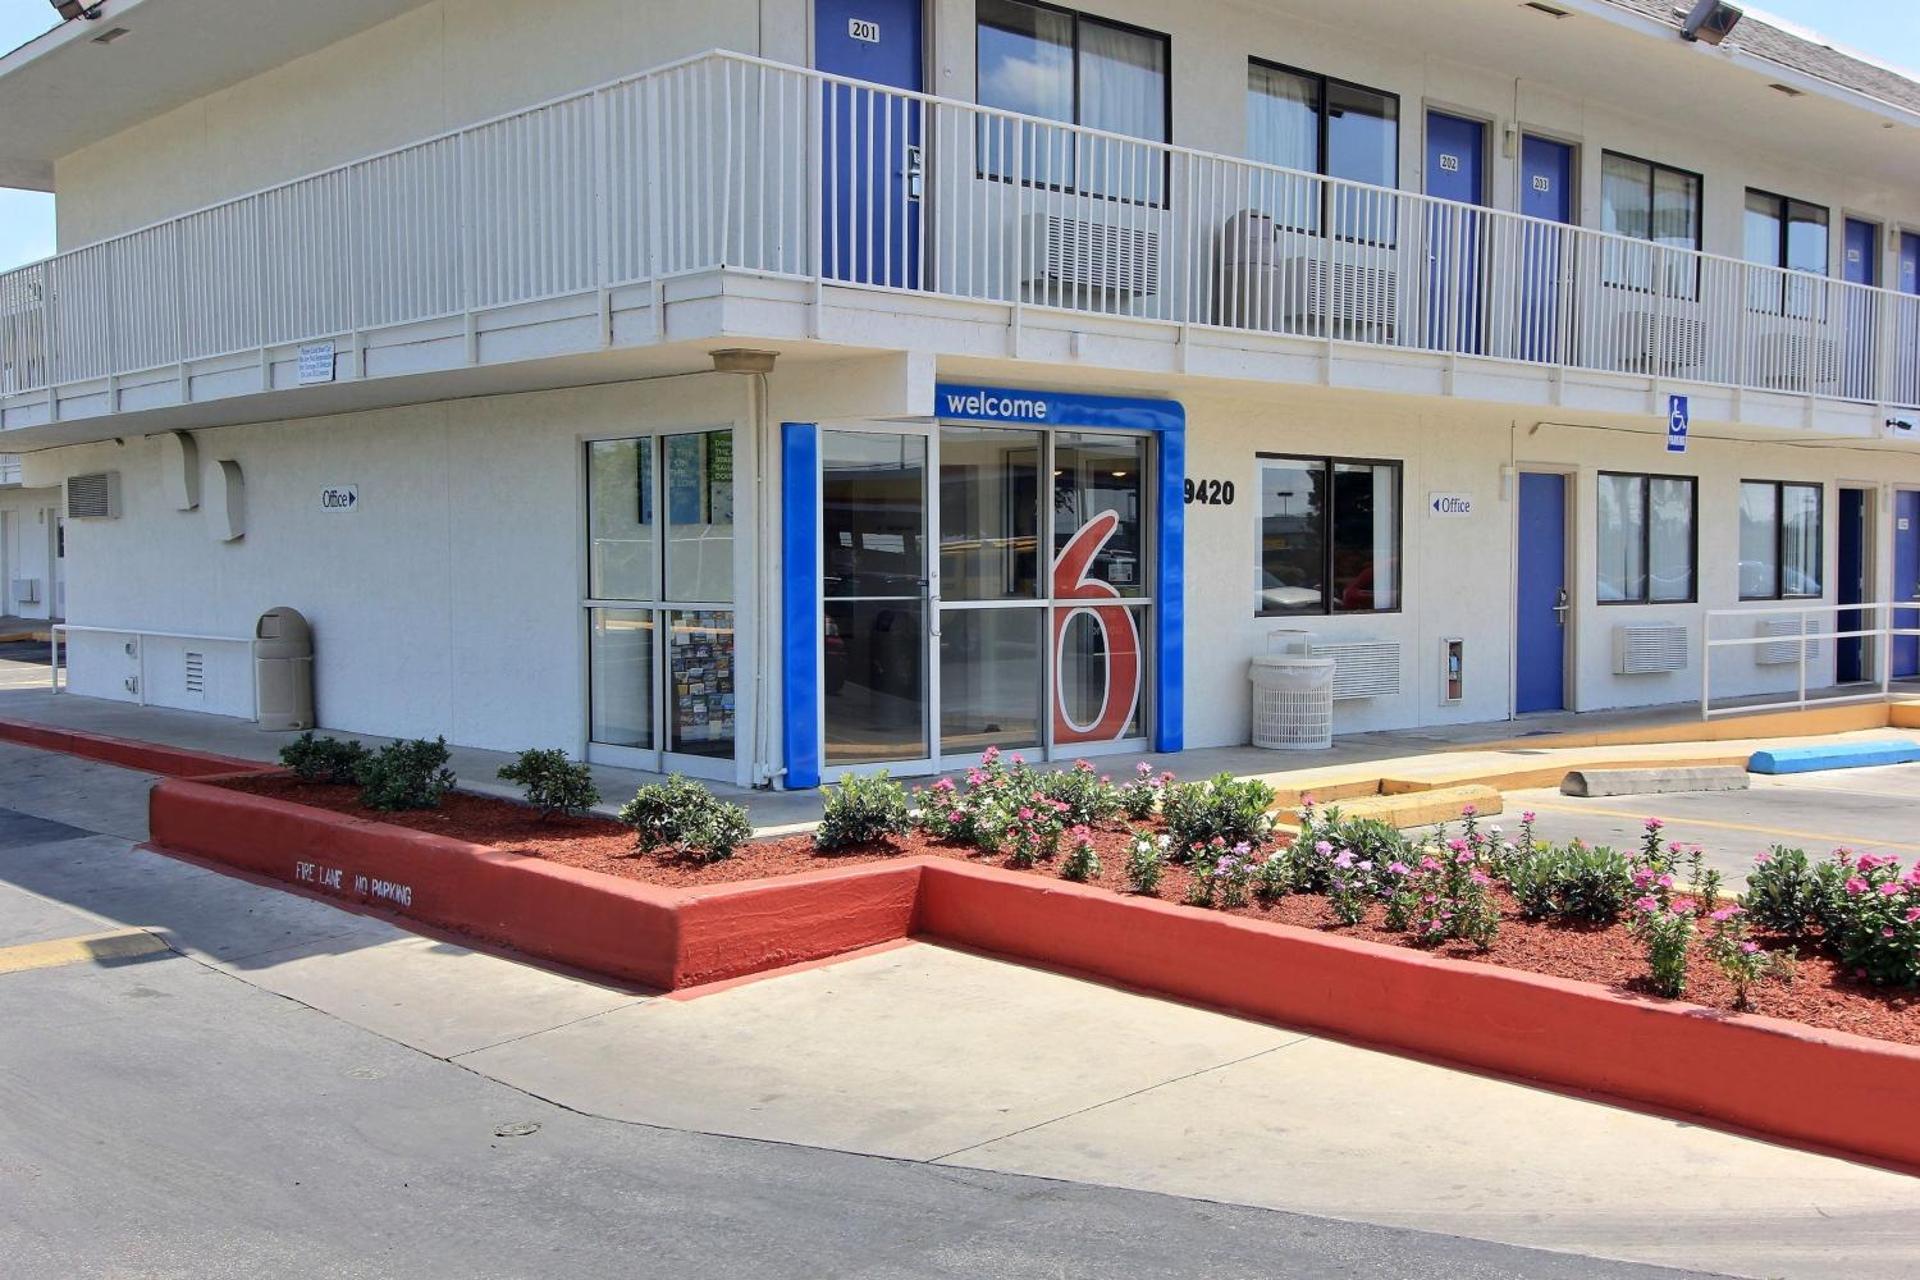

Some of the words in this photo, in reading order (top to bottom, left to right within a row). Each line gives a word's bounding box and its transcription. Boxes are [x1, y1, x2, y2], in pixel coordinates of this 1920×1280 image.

[853, 22, 875, 41] 201
[1442, 156, 1456, 170] 202
[947, 391, 1047, 419] welcome
[323, 490, 348, 508] Office
[1183, 478, 1235, 505] 9420
[1442, 497, 1470, 513] Office
[1054, 508, 1141, 746] 6
[297, 861, 316, 882] FIRE
[319, 866, 343, 889] LANE
[354, 875, 368, 896] NO
[371, 879, 412, 907] PARKING
